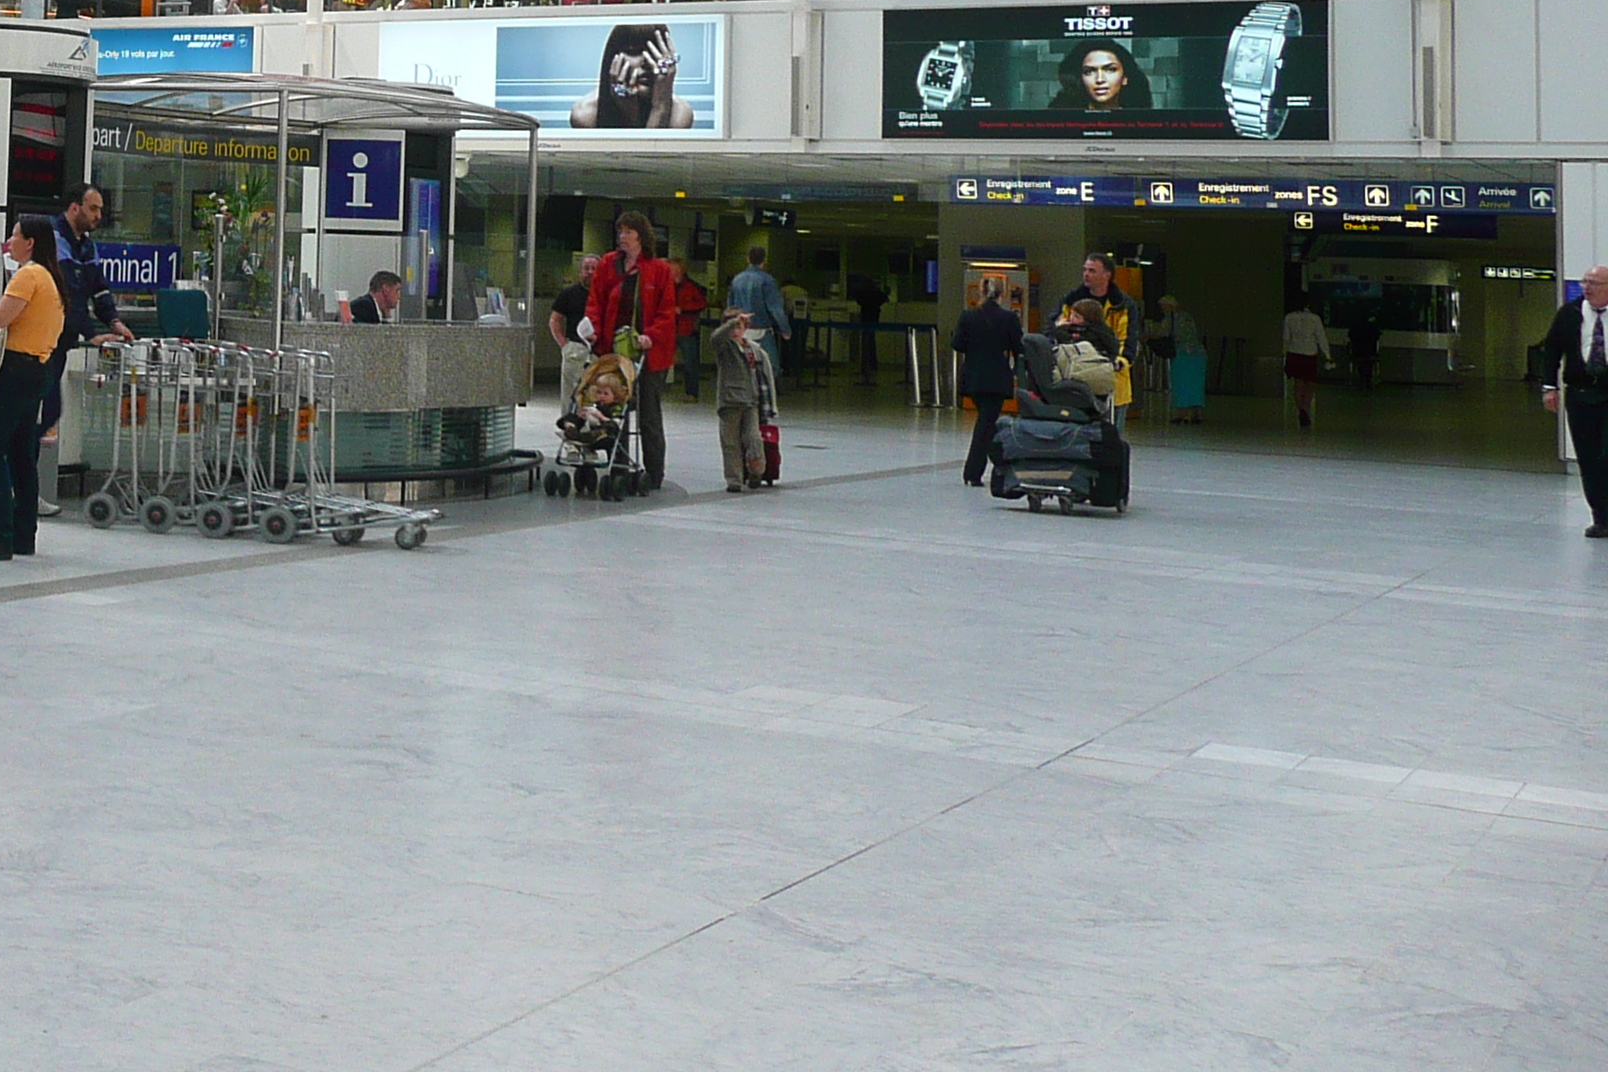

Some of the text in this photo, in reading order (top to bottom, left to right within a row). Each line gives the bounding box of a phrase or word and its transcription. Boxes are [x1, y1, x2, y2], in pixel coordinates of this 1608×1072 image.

[1063, 16, 1134, 31] TISSOT
[172, 33, 235, 42] AIR FRANCE
[131, 50, 146, 59] vols
[146, 50, 159, 60] par
[414, 63, 463, 87] Dior
[898, 111, 939, 121] Bien plus
[92, 122, 311, 162] part / Departure informaon
[986, 179, 1052, 190] Enregistrement
[1198, 182, 1271, 194] Enregistrement
[1055, 181, 1095, 202] zone E
[1274, 185, 1339, 206] zones FS
[1477, 186, 1518, 197] Arrivée
[1198, 195, 1241, 205] Check-in
[1478, 200, 1511, 209] Arrival
[1343, 213, 1403, 223] Enregistrement
[1344, 223, 1381, 232] Check-in
[1426, 214, 1440, 234] F
[168, 251, 178, 284] 1
